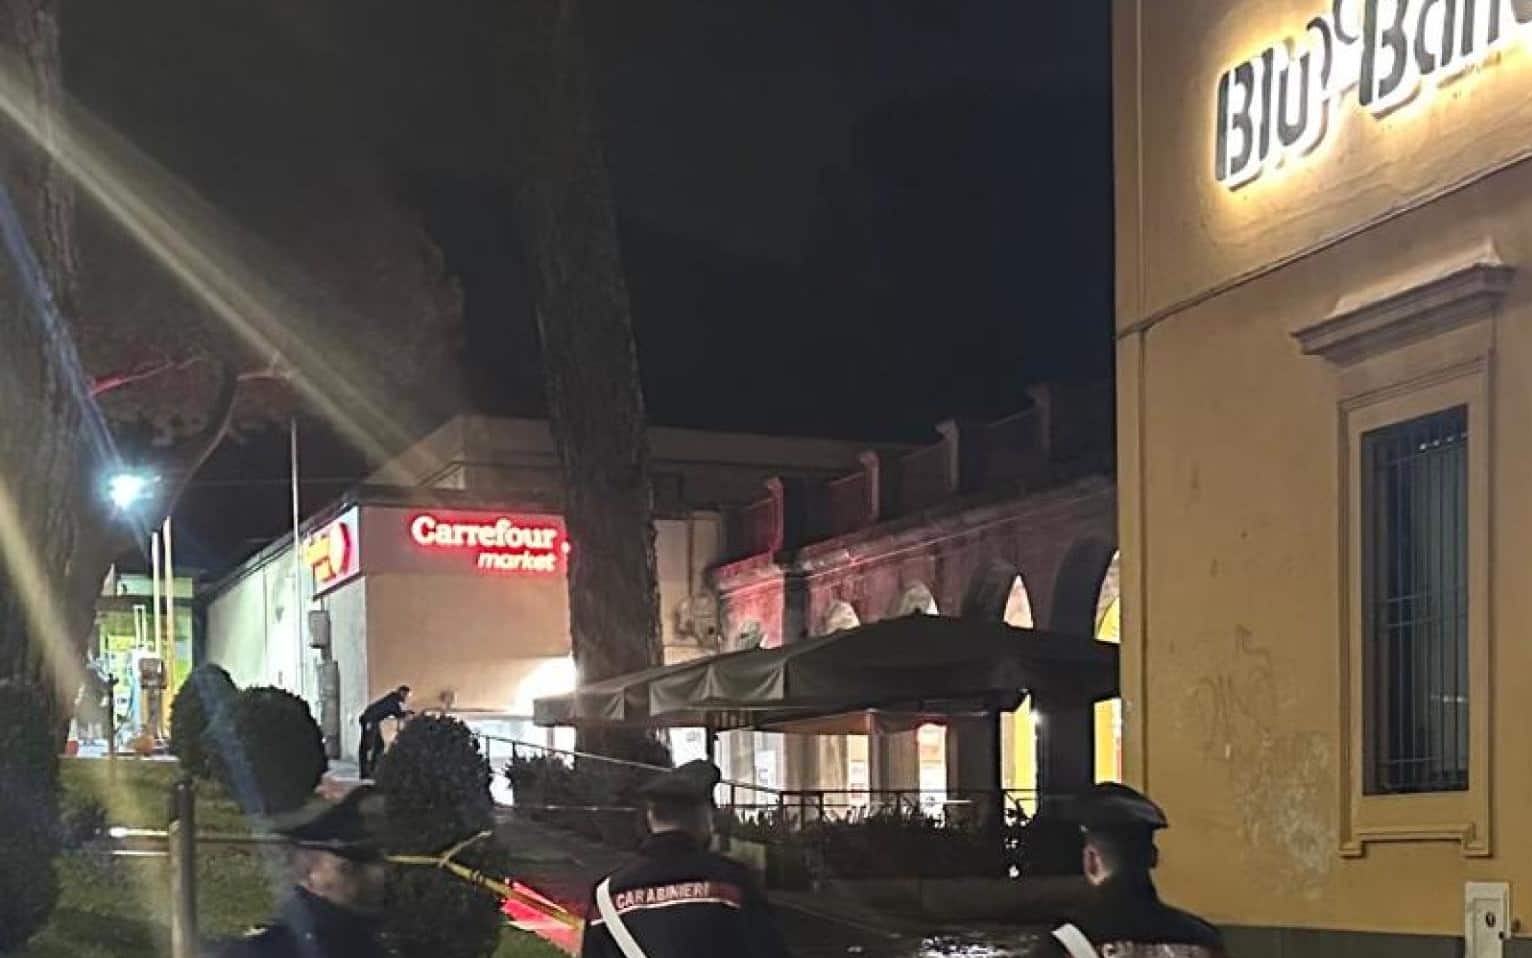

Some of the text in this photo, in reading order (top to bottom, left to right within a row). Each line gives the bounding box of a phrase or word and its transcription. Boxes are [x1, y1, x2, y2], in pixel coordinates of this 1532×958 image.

[1215, 44, 1311, 182] Blu
[411, 516, 557, 549] Carrefour
[477, 551, 556, 571] market
[615, 881, 710, 909] CARABINIERI
